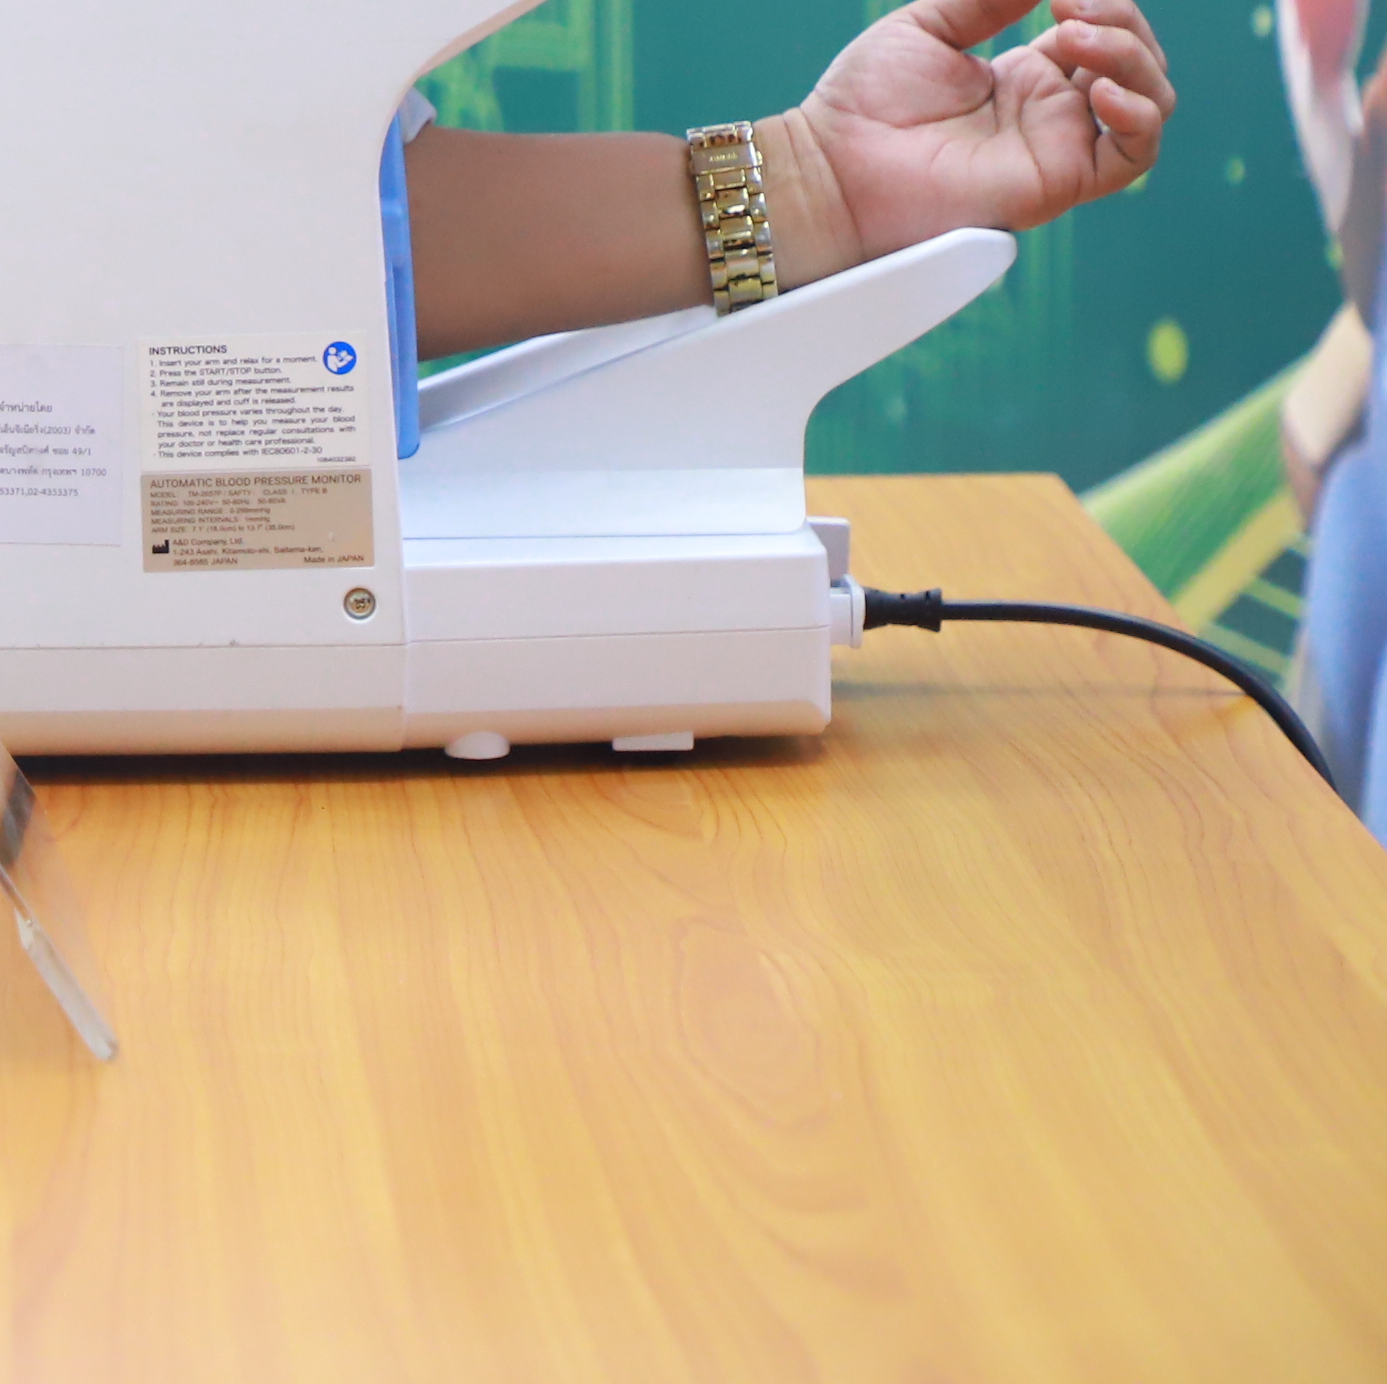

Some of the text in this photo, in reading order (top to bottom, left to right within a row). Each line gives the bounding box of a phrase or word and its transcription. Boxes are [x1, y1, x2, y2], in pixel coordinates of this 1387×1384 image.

[149, 345, 227, 355] INSTRUCTIONS
[159, 369, 181, 377] Press
[199, 367, 252, 376] START/STOP
[159, 379, 189, 387] Remain
[207, 379, 233, 387] during
[235, 377, 290, 385] measurement.
[160, 389, 192, 397] Remove
[233, 387, 252, 396] after
[270, 386, 325, 394] measurement
[176, 399, 214, 408] displayed
[265, 407, 310, 415] throughout
[327, 406, 343, 414] day.
[231, 418, 248, 426] help
[74, 425, 95, 434] จำกัด
[215, 429, 245, 437] replace
[249, 428, 277, 436] regular
[281, 426, 334, 434] consultations
[264, 437, 314, 446] professional.
[72, 447, 91, 455] 49/1
[158, 450, 174, 458] This
[204, 449, 239, 457] complies
[81, 468, 106, 476] 10700
[150, 474, 361, 488] AUTOMATIC BLOOD PRESSURE MONITOR
[172, 538, 189, 546] A&D
[211, 557, 237, 565] JAPAN
